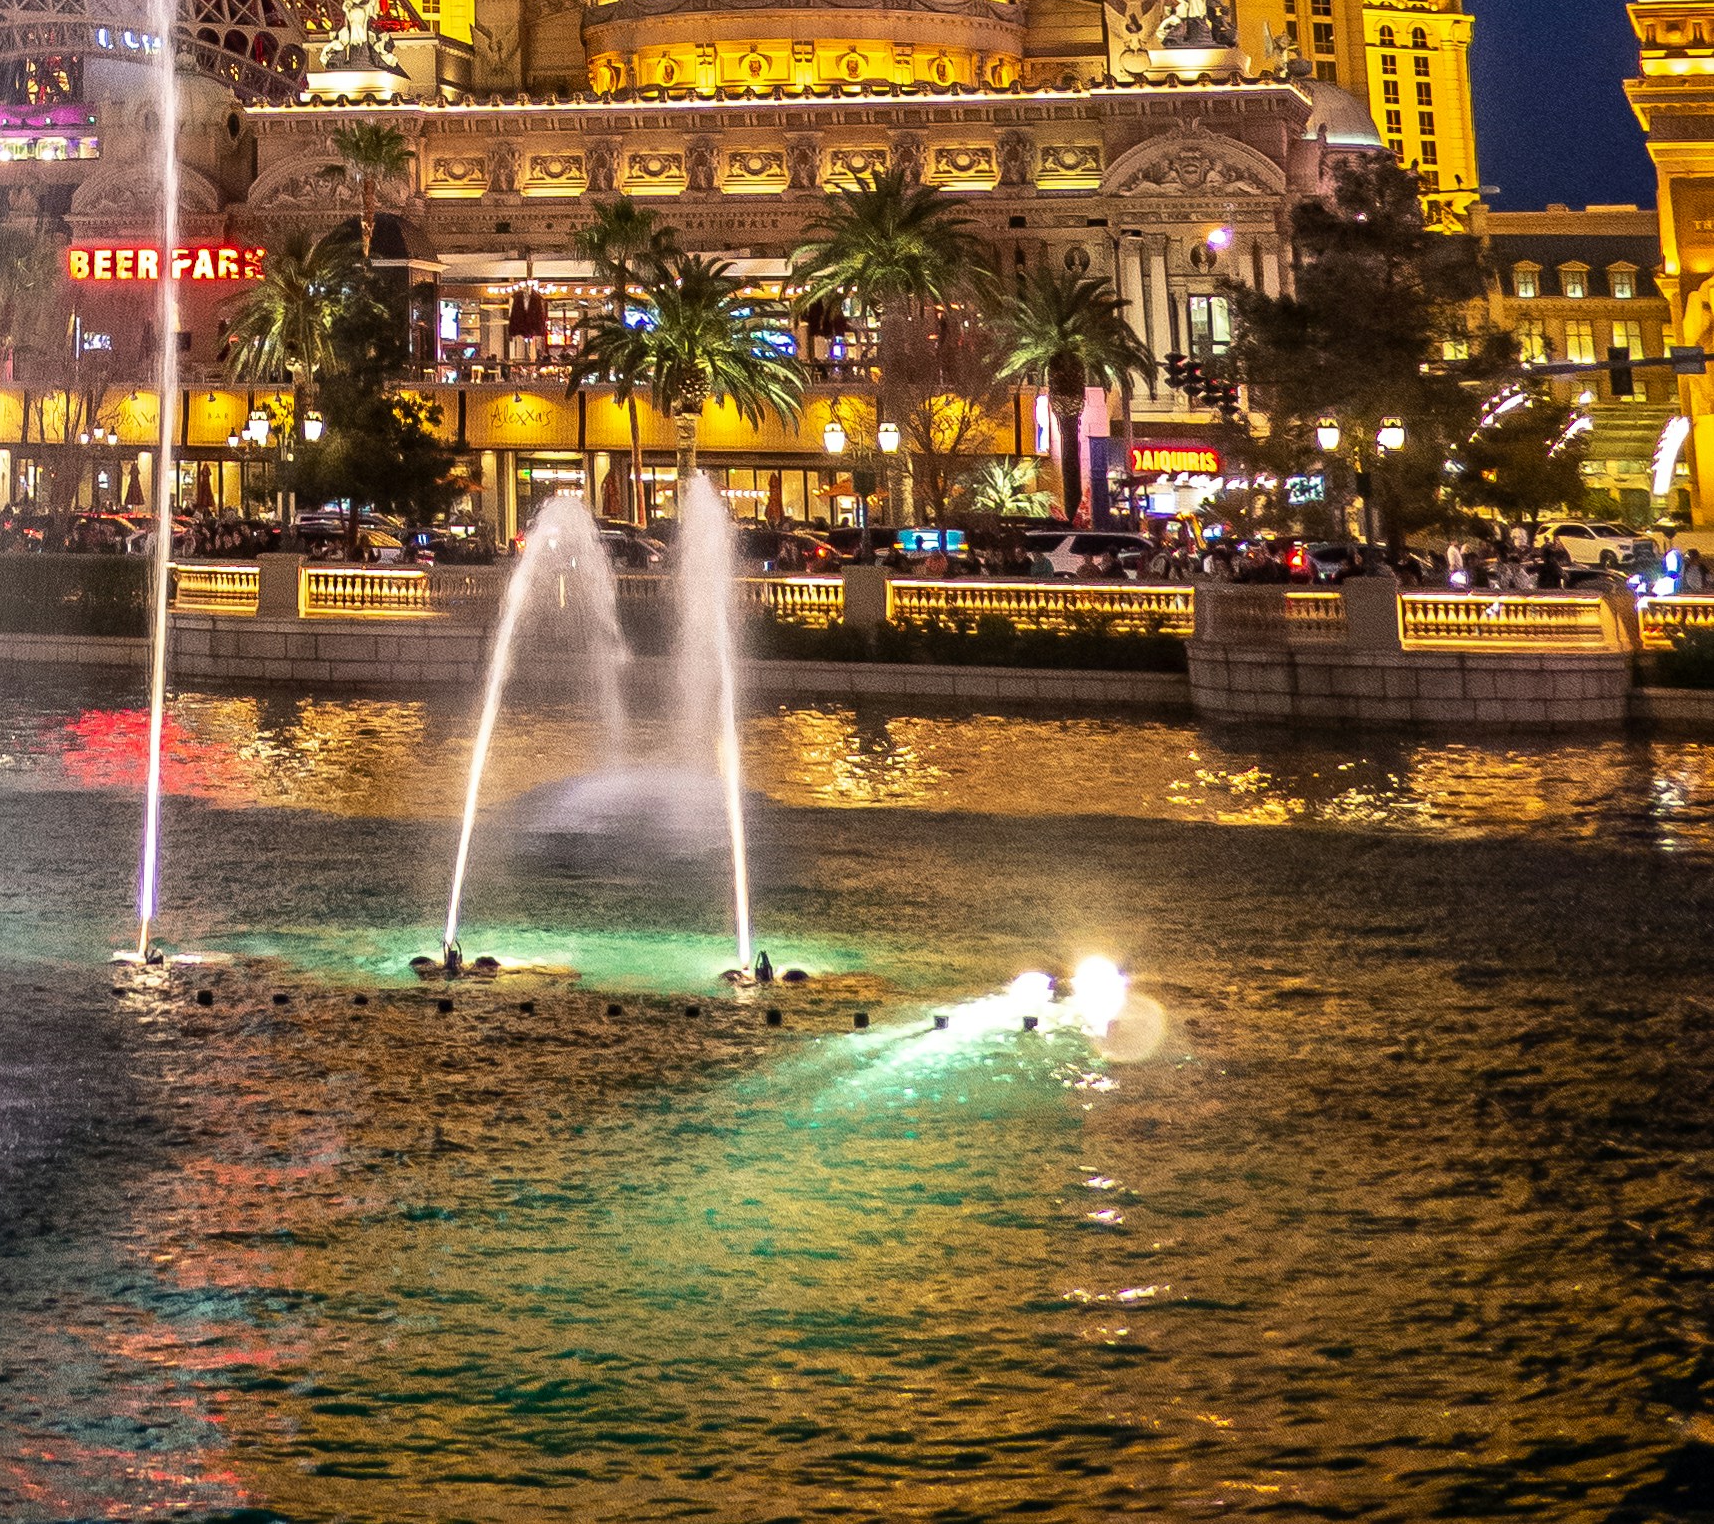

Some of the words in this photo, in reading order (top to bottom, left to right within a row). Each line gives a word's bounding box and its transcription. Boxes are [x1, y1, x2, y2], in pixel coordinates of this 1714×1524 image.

[69, 249, 159, 280] BEER
[171, 248, 266, 281] PARK
[207, 412, 229, 421] BAR
